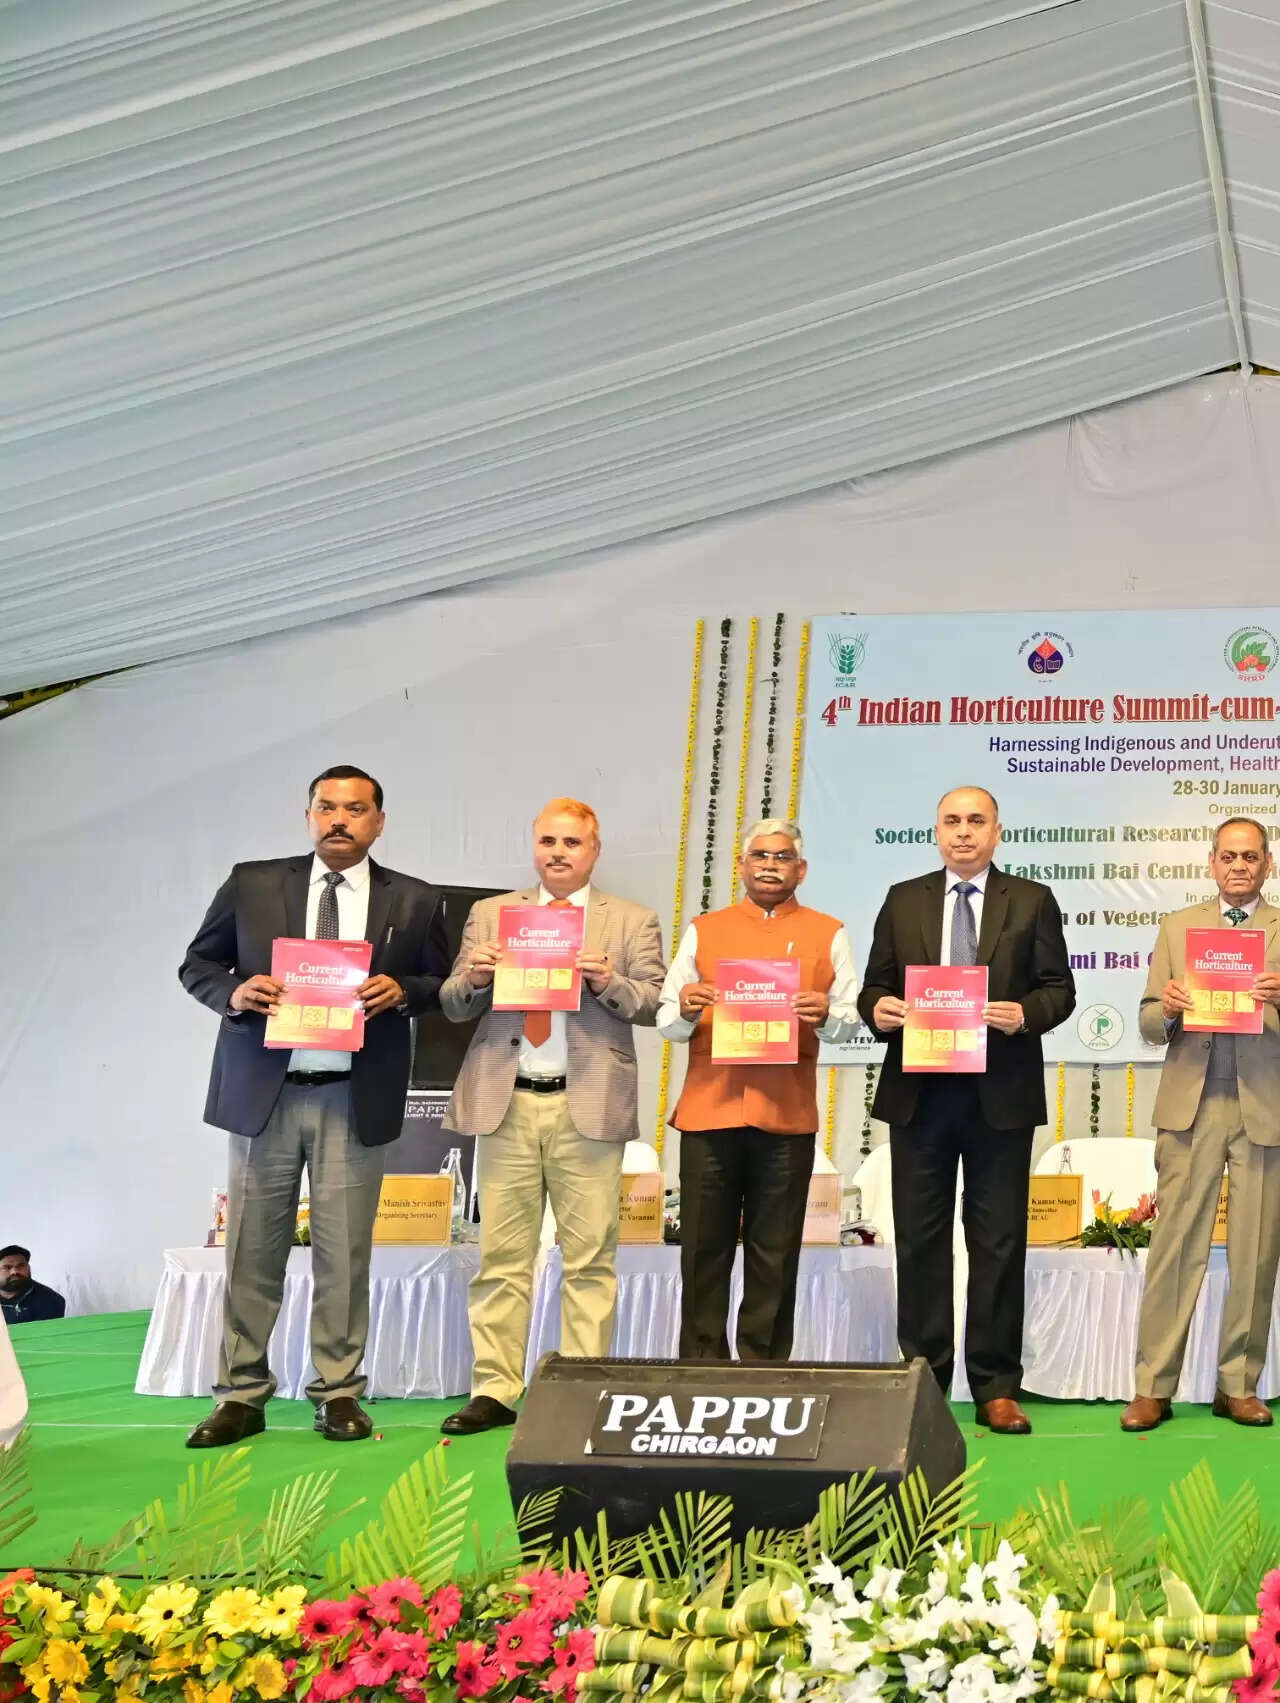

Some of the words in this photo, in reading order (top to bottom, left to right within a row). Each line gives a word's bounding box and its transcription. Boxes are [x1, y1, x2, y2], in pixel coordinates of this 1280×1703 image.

[820, 696, 852, 726] 4th
[858, 697, 941, 725] Indian
[949, 695, 1105, 723] Horticulture
[989, 736, 1080, 754] Harnessing
[1084, 735, 1175, 754] Indigenous
[1180, 735, 1211, 750] and
[1007, 757, 1105, 773] Sustainable
[1111, 756, 1224, 774] Development,
[1172, 780, 1219, 796] 28-30
[1208, 803, 1276, 816] Organized
[1001, 825, 1115, 843] orticultural
[1103, 863, 1140, 879] Bai
[1147, 862, 1213, 879] Centra
[1185, 891, 1197, 903] In
[1076, 910, 1095, 926] of
[519, 928, 559, 937] Current
[508, 937, 571, 948] Horticulture
[1104, 952, 1140, 969] Bai
[1205, 950, 1243, 960] Current
[1195, 960, 1253, 970] Horticulture
[735, 980, 776, 990] Current
[725, 990, 787, 1001] Horticulture
[925, 988, 963, 998] Current
[914, 998, 975, 1008] Horticulture
[627, 1194, 656, 1202] Kumar
[602, 1394, 816, 1435] PAPPU
[631, 1434, 777, 1455] CHIRGAON
